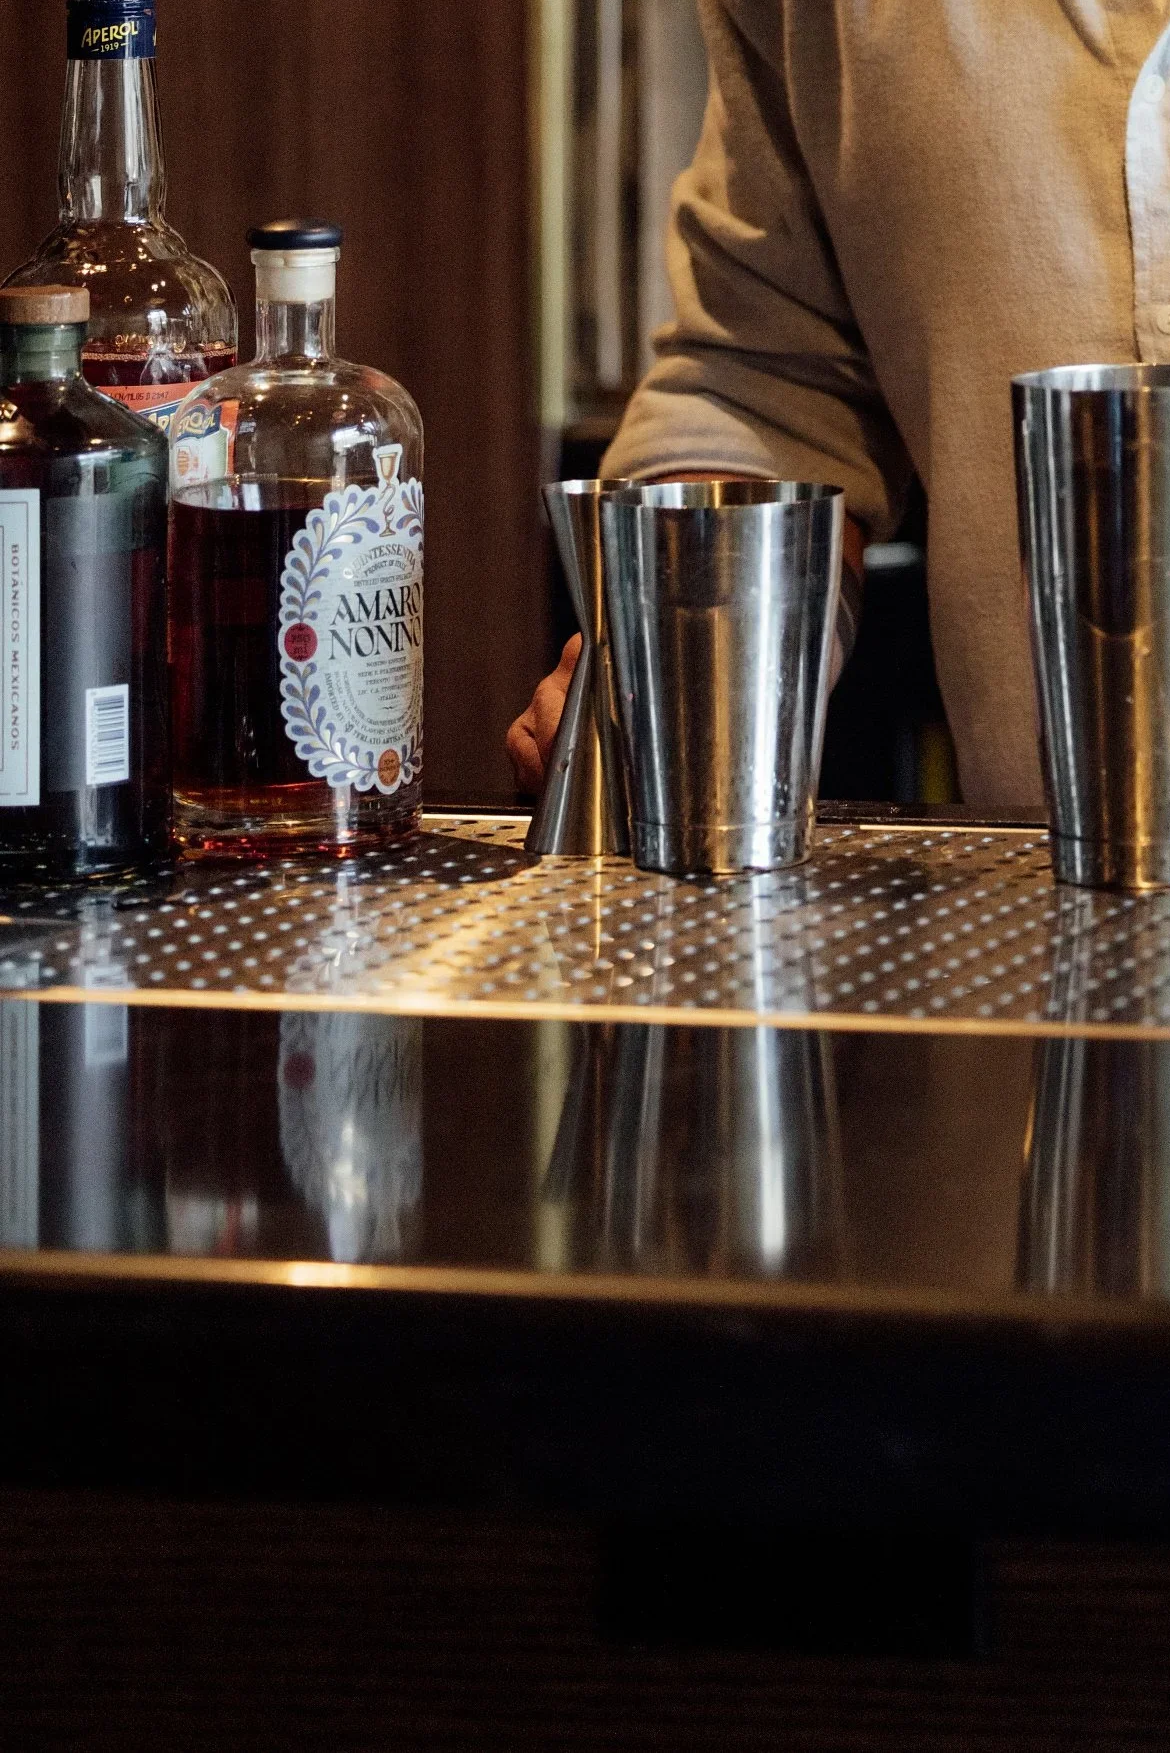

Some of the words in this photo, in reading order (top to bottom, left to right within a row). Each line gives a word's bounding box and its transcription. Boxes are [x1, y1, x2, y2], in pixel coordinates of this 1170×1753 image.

[81, 20, 139, 48] APEROL
[100, 43, 119, 53] 1919
[330, 581, 421, 626] AMARO
[328, 615, 421, 661] NONINO
[11, 650, 20, 750] MEXICANOS
